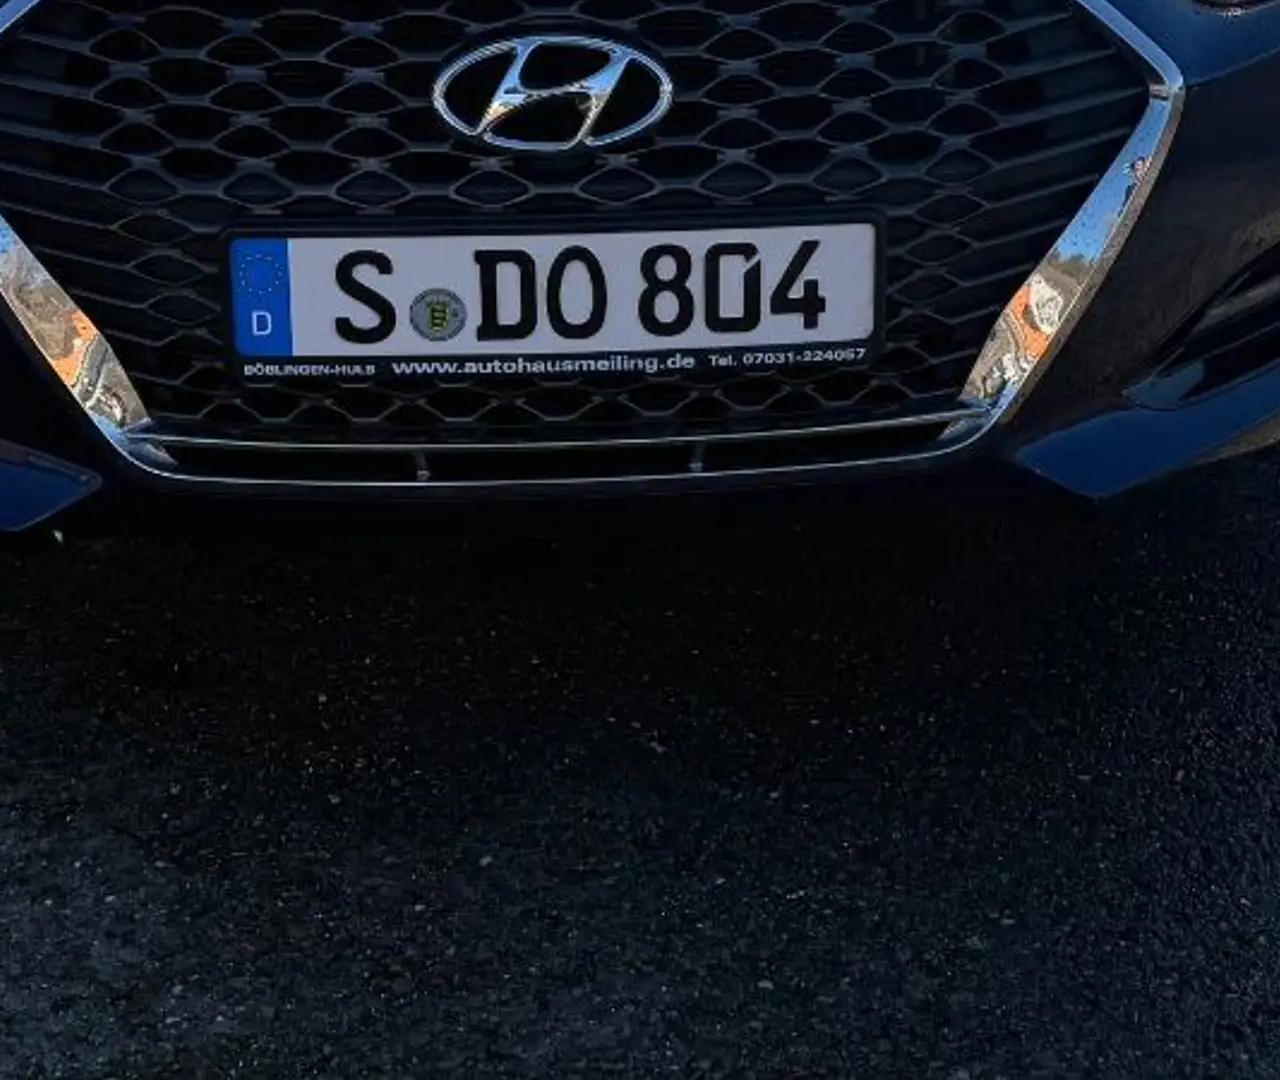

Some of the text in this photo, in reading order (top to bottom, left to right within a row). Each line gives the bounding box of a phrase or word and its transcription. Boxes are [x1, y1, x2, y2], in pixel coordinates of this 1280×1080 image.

[335, 239, 826, 344] S DO 804
[252, 311, 271, 336] D
[391, 354, 695, 375] www.autohausmeiling.de
[708, 354, 737, 367] Tel.
